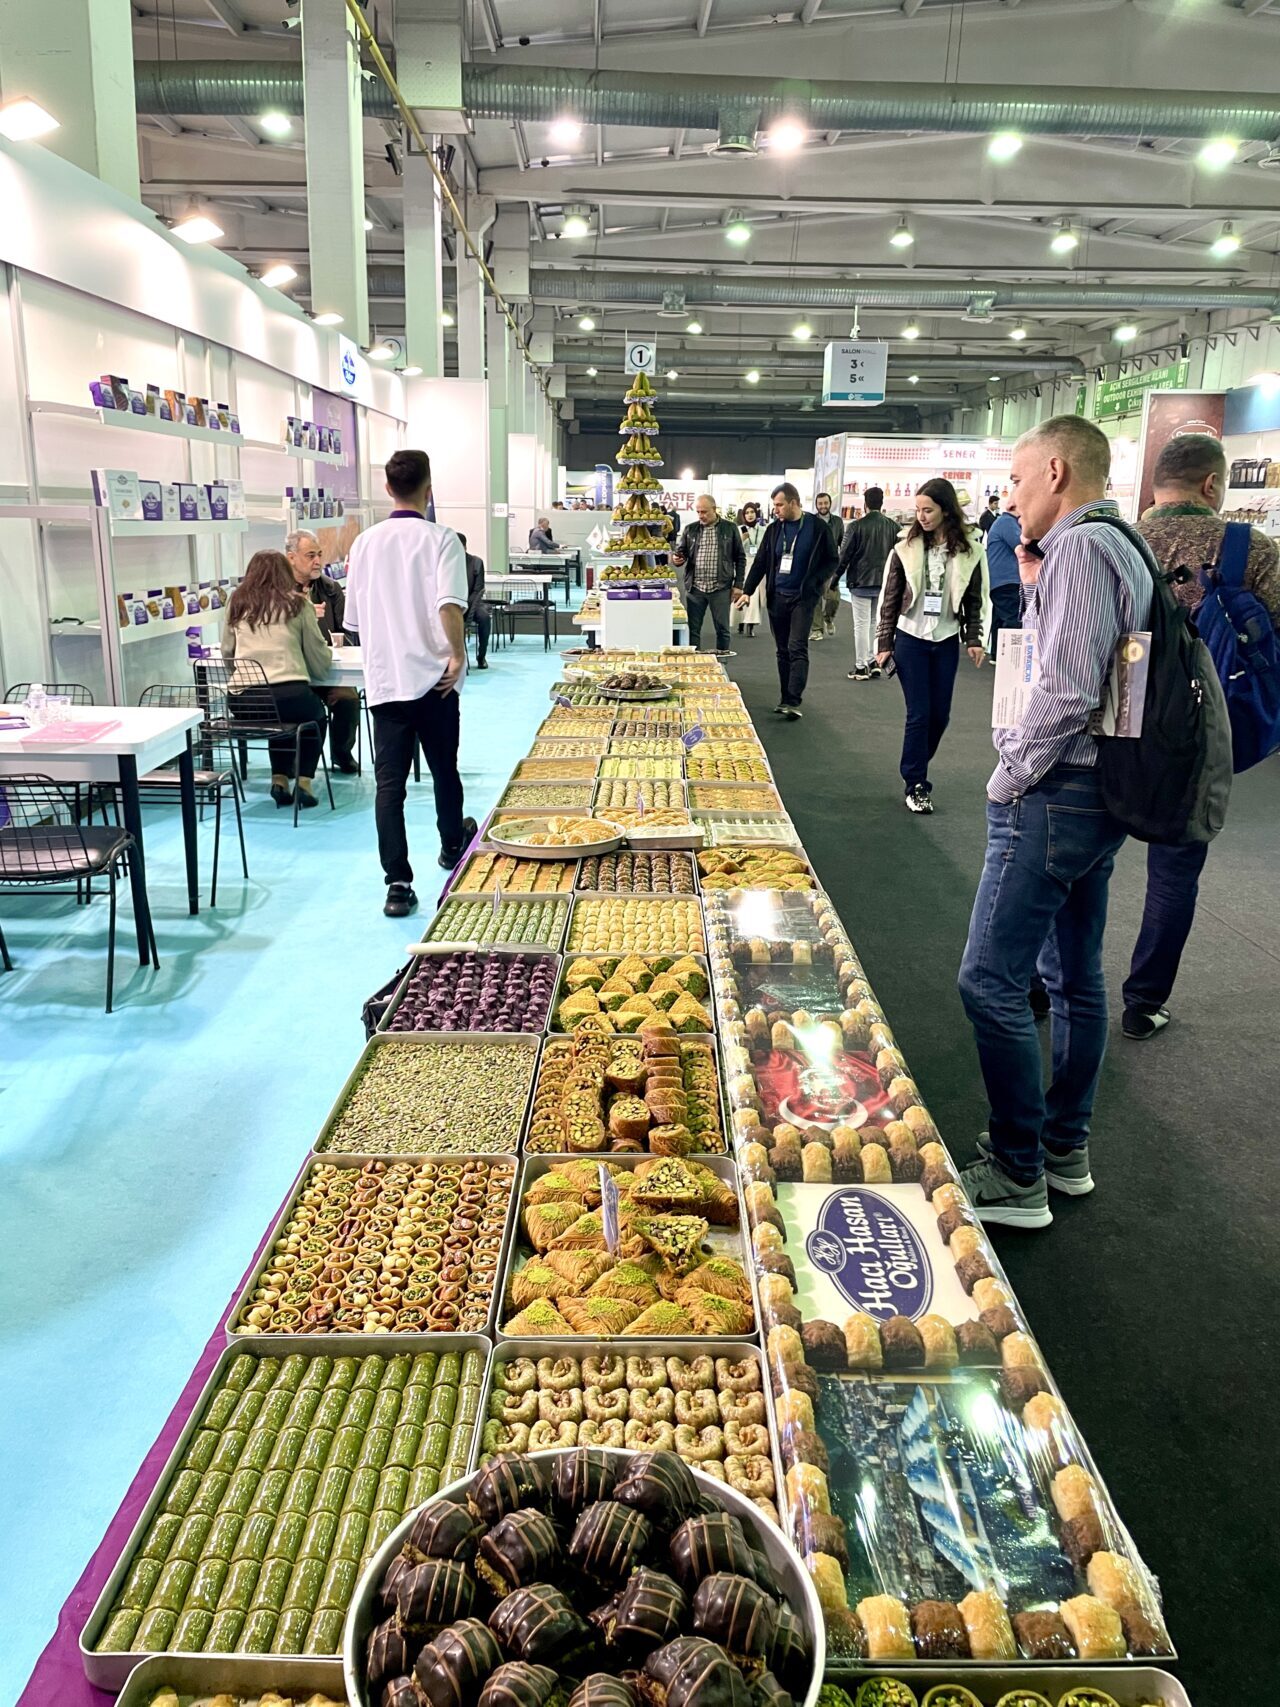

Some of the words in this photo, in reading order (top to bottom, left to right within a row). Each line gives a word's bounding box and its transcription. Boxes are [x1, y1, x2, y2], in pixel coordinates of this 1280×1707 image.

[637, 350, 643, 363] 1
[850, 359, 858, 369] 3
[849, 374, 857, 383] 5
[659, 492, 696, 502] TASTE
[839, 1196, 881, 1259] Hasan
[876, 1216, 919, 1290] Oğulları
[858, 1260, 899, 1316] Hacı
